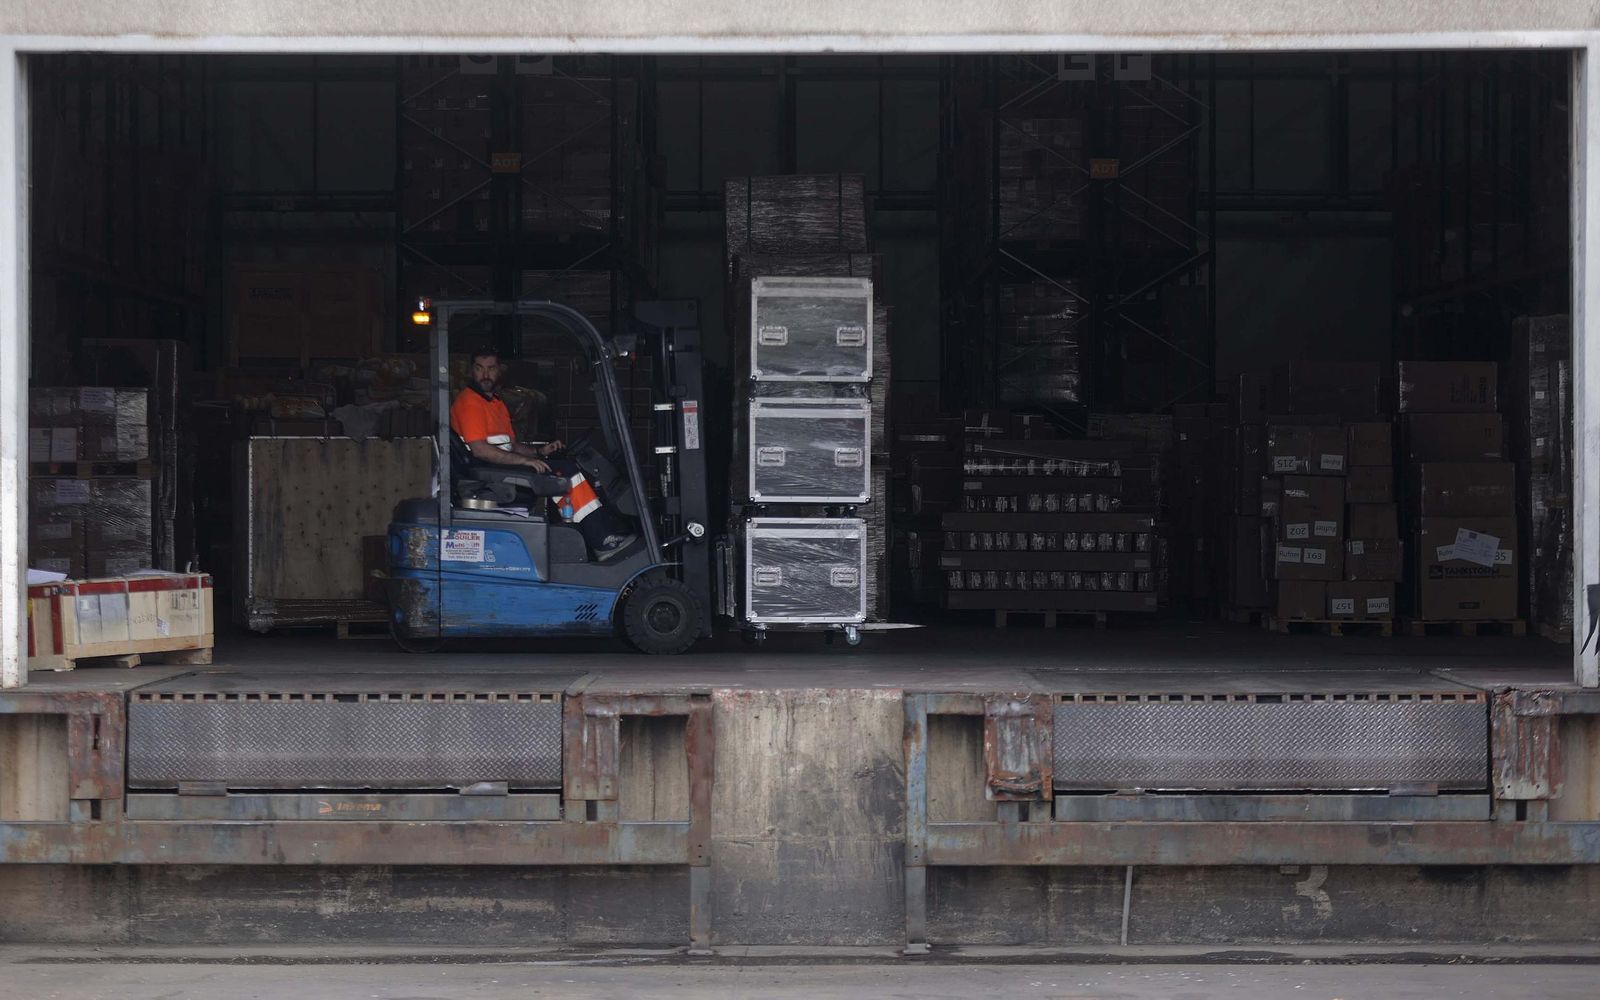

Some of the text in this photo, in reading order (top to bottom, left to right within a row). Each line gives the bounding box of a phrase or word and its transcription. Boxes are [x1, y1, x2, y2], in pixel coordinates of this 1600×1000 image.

[1277, 459, 1293, 468] 215
[1289, 527, 1306, 536] 202
[1306, 552, 1322, 560] 163
[1335, 602, 1352, 610] 157
